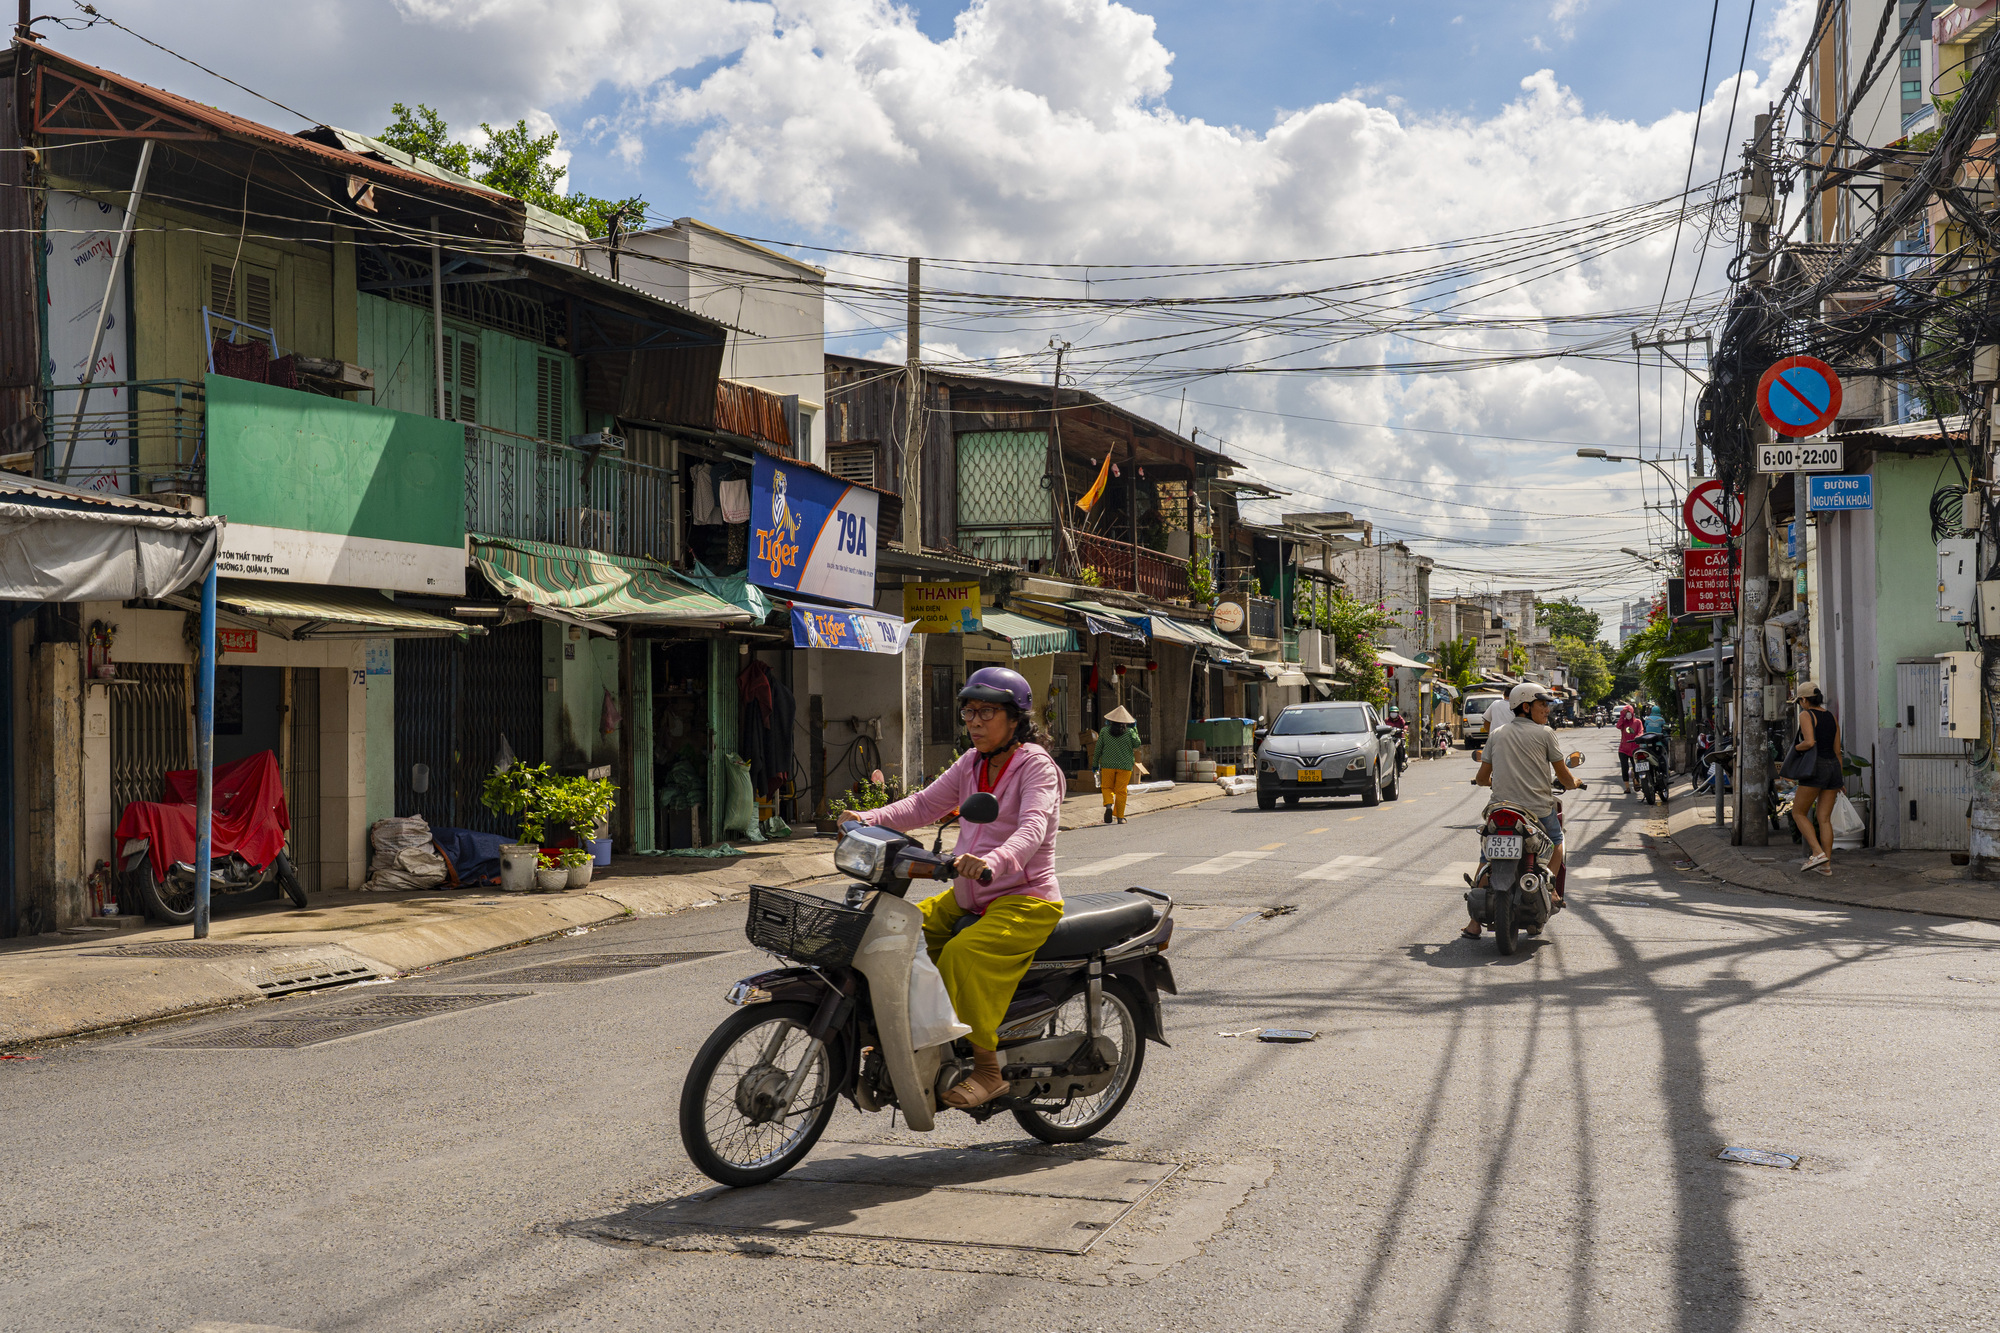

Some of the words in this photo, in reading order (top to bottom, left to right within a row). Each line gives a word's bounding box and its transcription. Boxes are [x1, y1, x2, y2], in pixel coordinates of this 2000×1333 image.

[1763, 450, 1793, 466] 6:00
[1802, 449, 1838, 465] 22:00
[1824, 479, 1859, 490] ĐƯỜNG
[1813, 492, 1845, 507] NGUYỄN
[1846, 492, 1870, 506] KHOÁI
[836, 510, 867, 557] 79A
[222, 550, 235, 560] TÔN
[236, 551, 251, 561] THẤT
[251, 552, 274, 563] THUYẾT
[756, 528, 799, 578] Tiger
[246, 564, 263, 575] QUẬN
[270, 567, 290, 575] TPHCM
[1688, 567, 1700, 577] CÁC
[1701, 568, 1714, 578] LOẠI
[1687, 579, 1695, 589] VÀ
[1704, 579, 1715, 588] THÔ
[915, 587, 969, 601] THANH
[1699, 592, 1713, 600] 5:00
[910, 604, 924, 612] HÀN
[925, 605, 941, 613] ĐIỆN
[1698, 602, 1714, 610] 16:00
[926, 614, 938, 622] GIÓ
[816, 614, 847, 646] Tiger
[877, 621, 898, 643] 79A
[353, 670, 366, 685] 79
[1492, 837, 1516, 847] 59-Z1
[1487, 847, 1520, 858] 065.52
